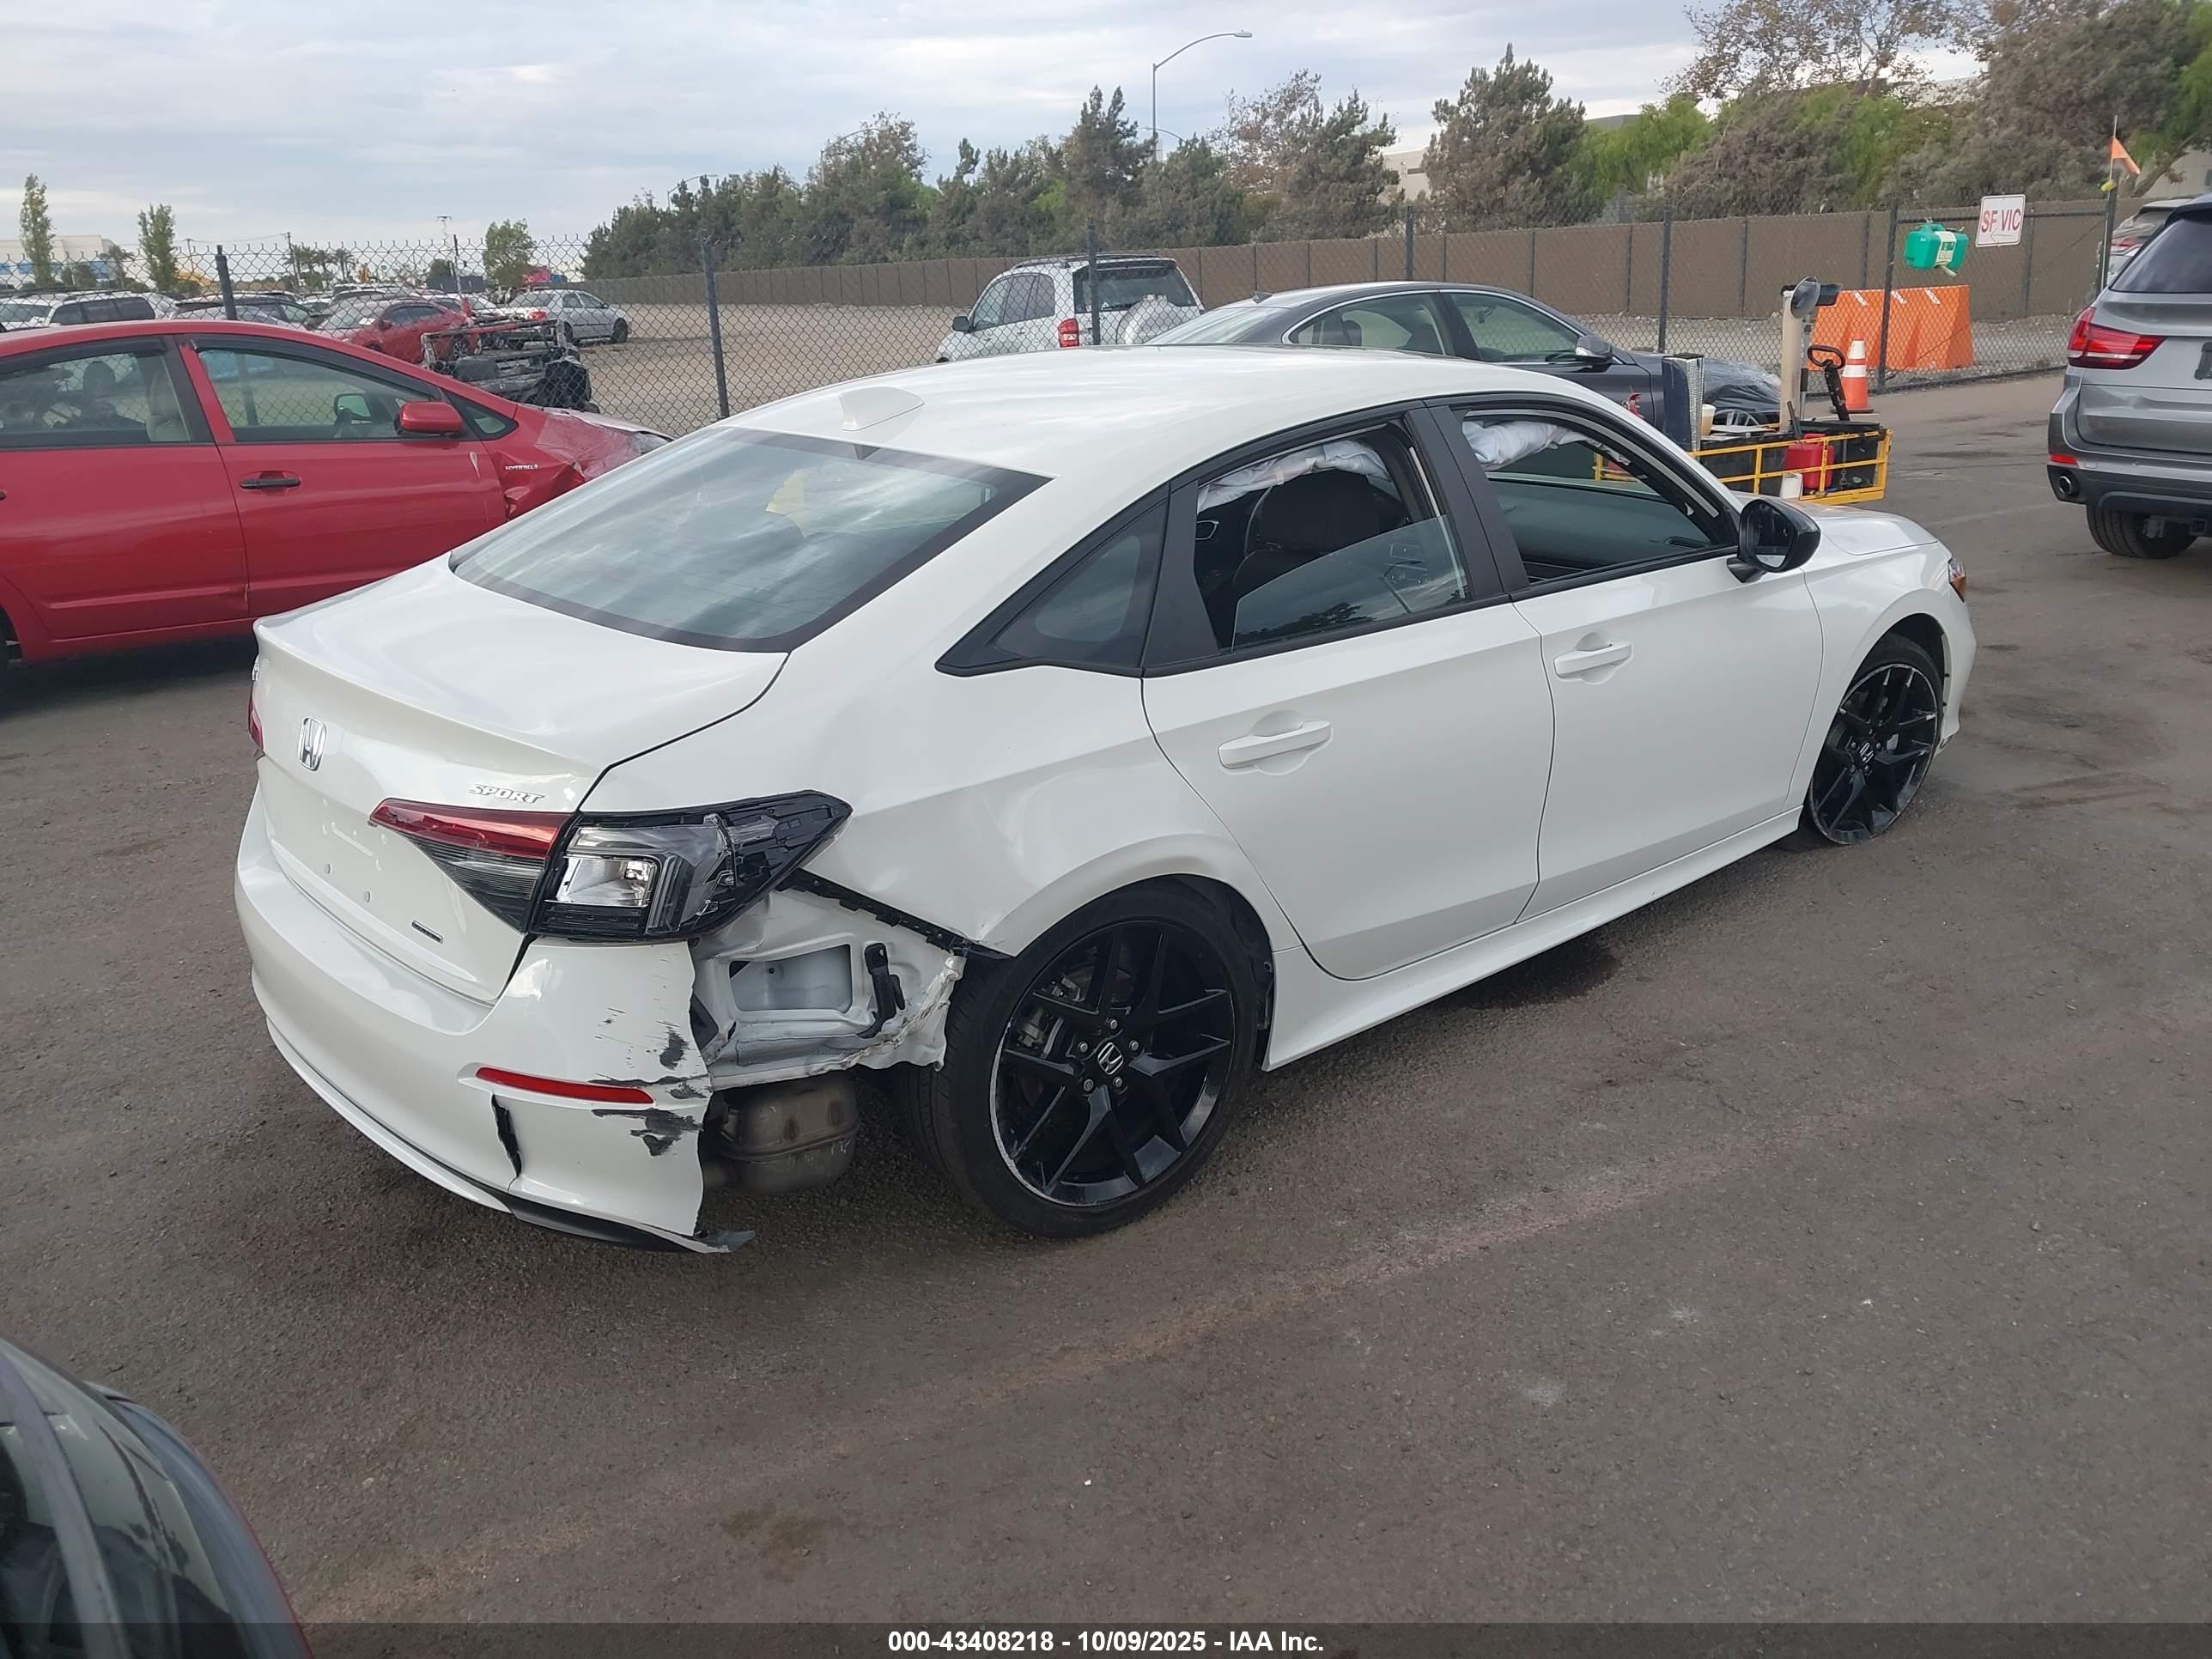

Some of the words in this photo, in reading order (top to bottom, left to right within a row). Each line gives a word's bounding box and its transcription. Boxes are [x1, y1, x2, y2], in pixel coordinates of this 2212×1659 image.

[1981, 210, 1998, 233] SF
[2001, 209, 2021, 231] VIC
[468, 784, 545, 804] SPORT
